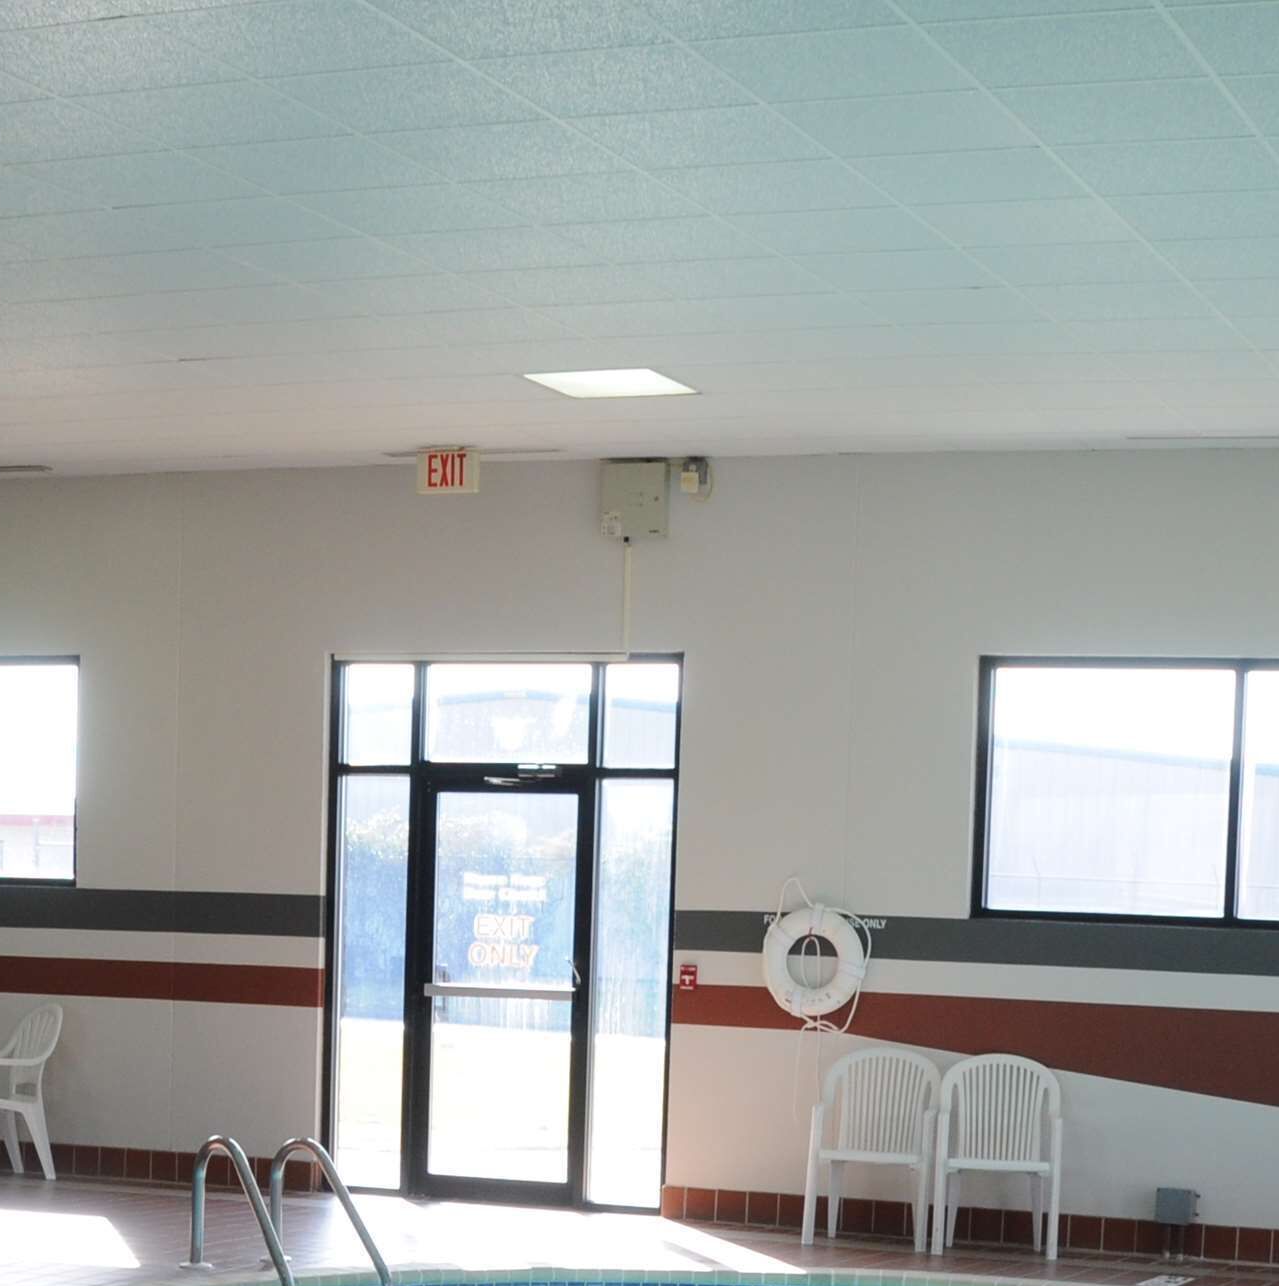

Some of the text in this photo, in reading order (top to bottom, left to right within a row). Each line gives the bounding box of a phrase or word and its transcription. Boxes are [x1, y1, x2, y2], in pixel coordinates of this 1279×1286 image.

[428, 453, 466, 487] EXIT
[474, 914, 536, 939] EXIT
[468, 943, 539, 967] ONLY
